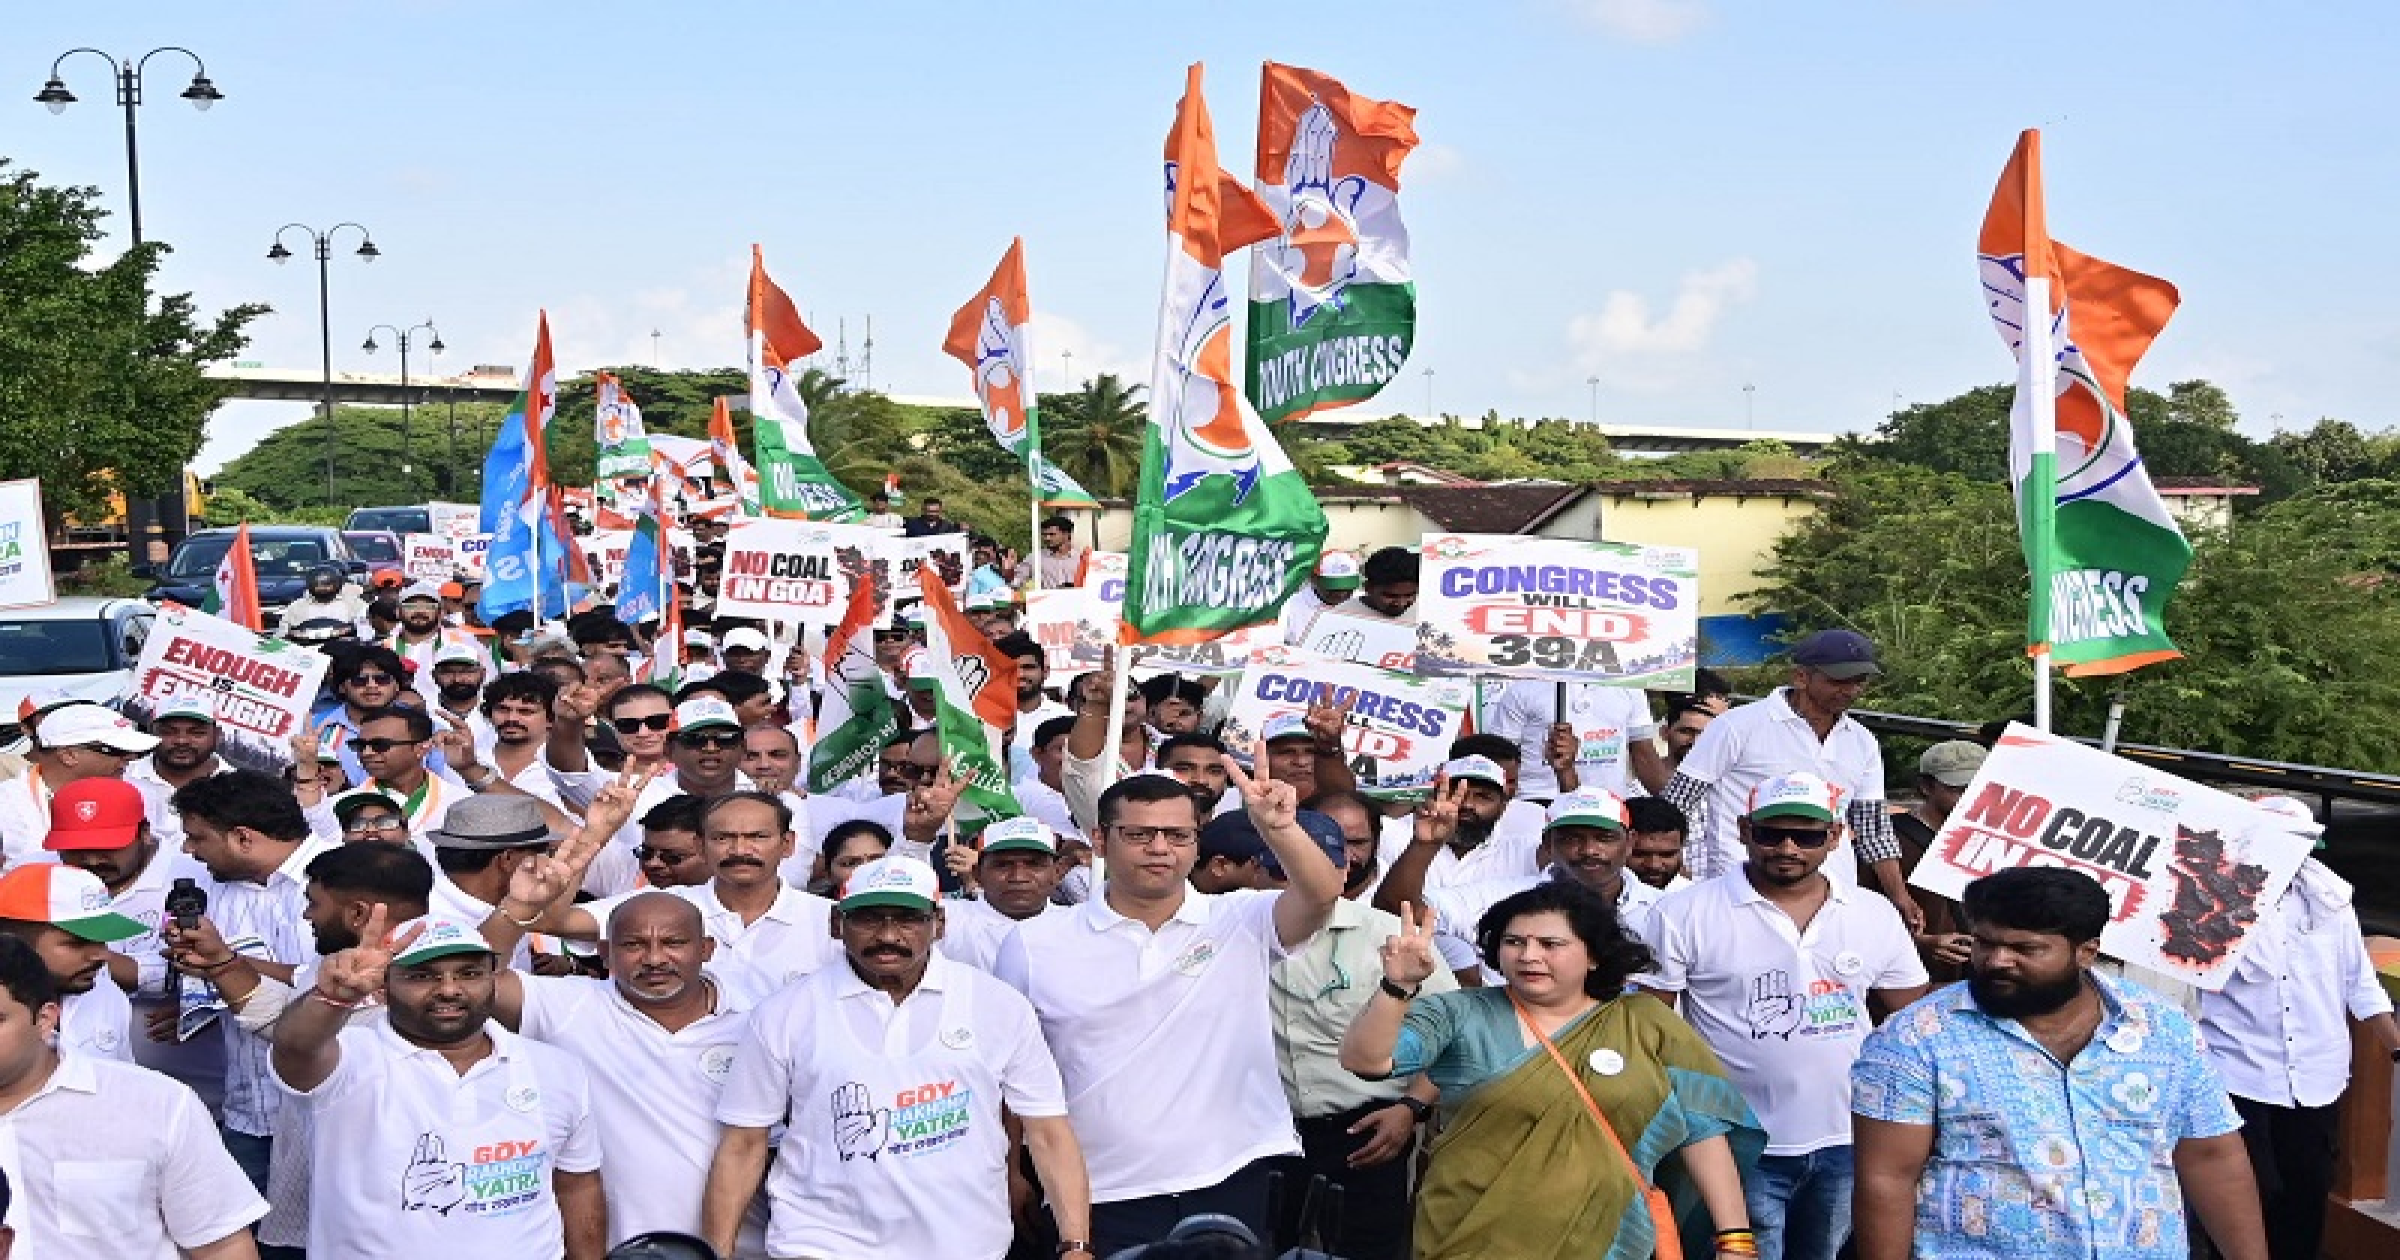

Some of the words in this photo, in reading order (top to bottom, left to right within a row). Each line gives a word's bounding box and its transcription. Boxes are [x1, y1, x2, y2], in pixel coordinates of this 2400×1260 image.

[728, 551, 769, 576] NO
[771, 552, 832, 580] COAL
[732, 579, 765, 600] IN
[770, 580, 827, 604] GOA
[1440, 565, 1678, 610] CONGRESS
[1521, 593, 1597, 609] WILL
[1484, 607, 1631, 641] END
[162, 636, 303, 698] ENOUGH
[1487, 634, 1624, 673] 39A
[212, 676, 234, 692] IS
[1964, 781, 2052, 838] NO
[2040, 807, 2161, 879] COAL
[896, 1080, 955, 1108] GOY
[896, 1108, 970, 1140] YATRA
[473, 1140, 537, 1164] GOY
[472, 1172, 540, 1200] YATRA
